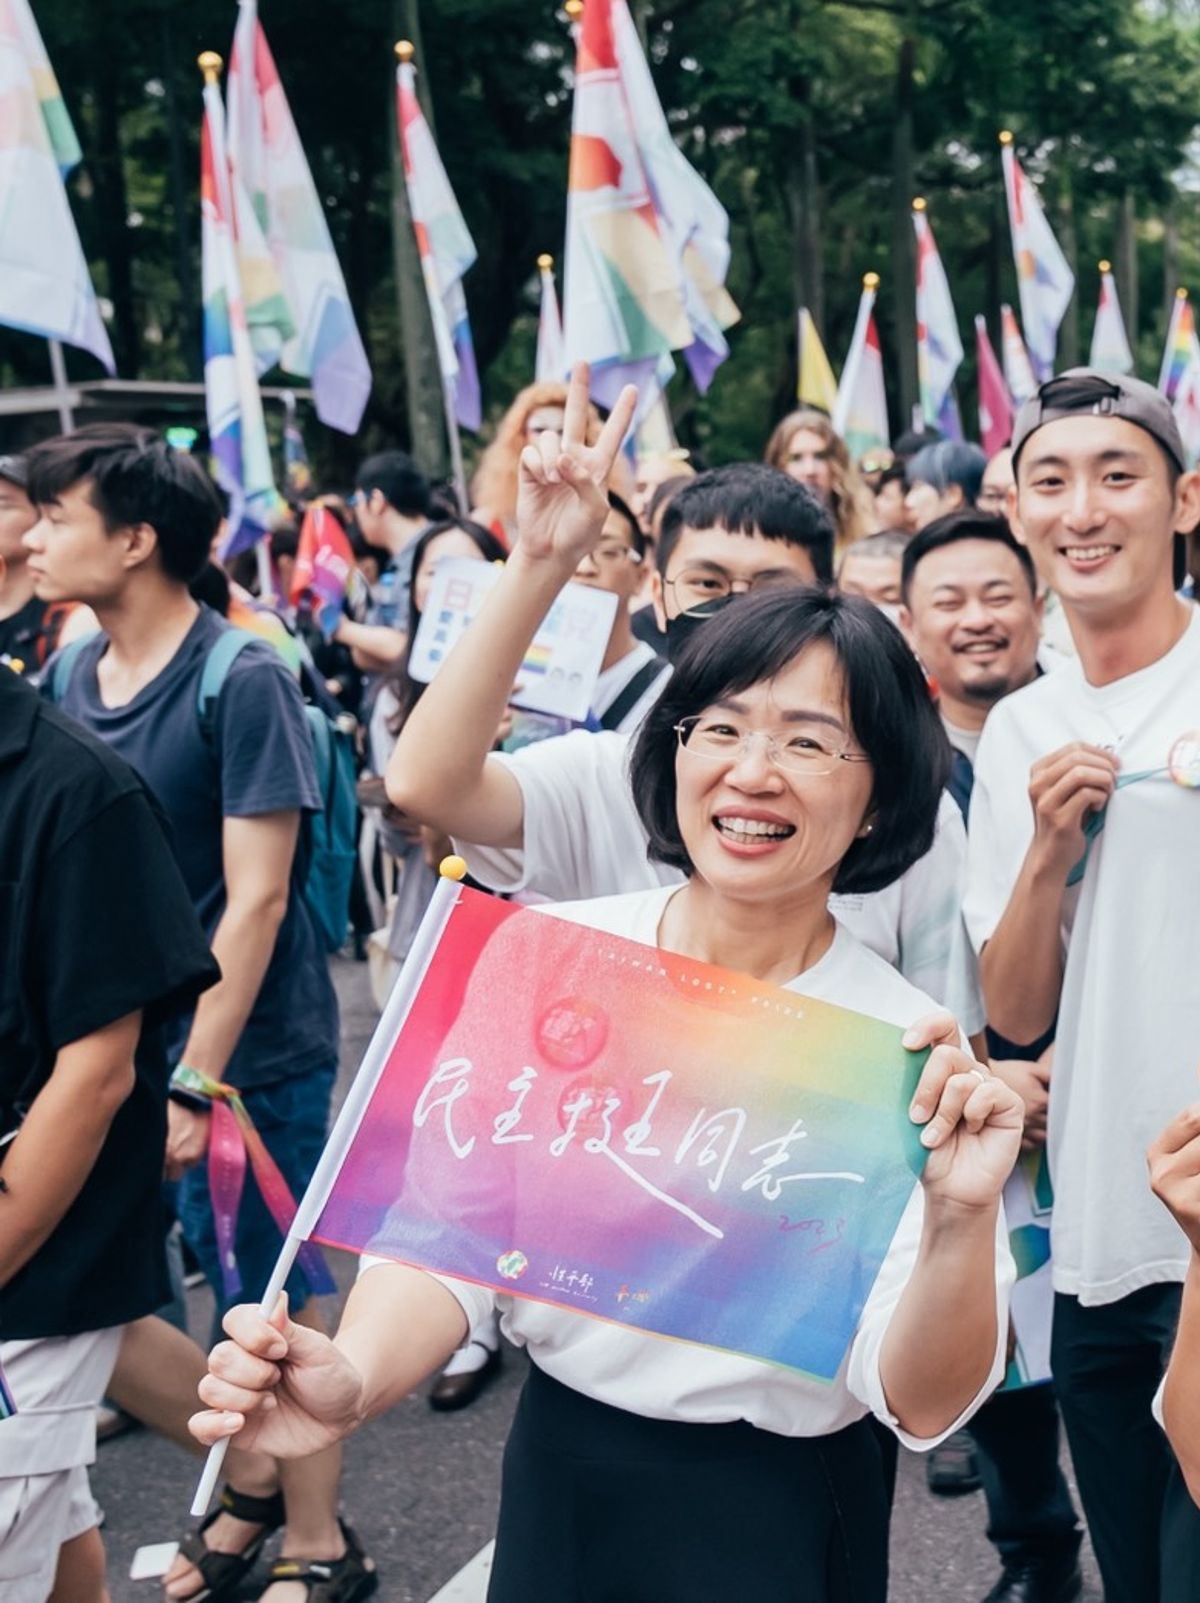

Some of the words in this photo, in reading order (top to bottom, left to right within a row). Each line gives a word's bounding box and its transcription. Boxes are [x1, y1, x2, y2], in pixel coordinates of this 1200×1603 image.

[751, 994, 805, 1021] PRIDE
[412, 1057, 865, 1239] 民主挺同志
